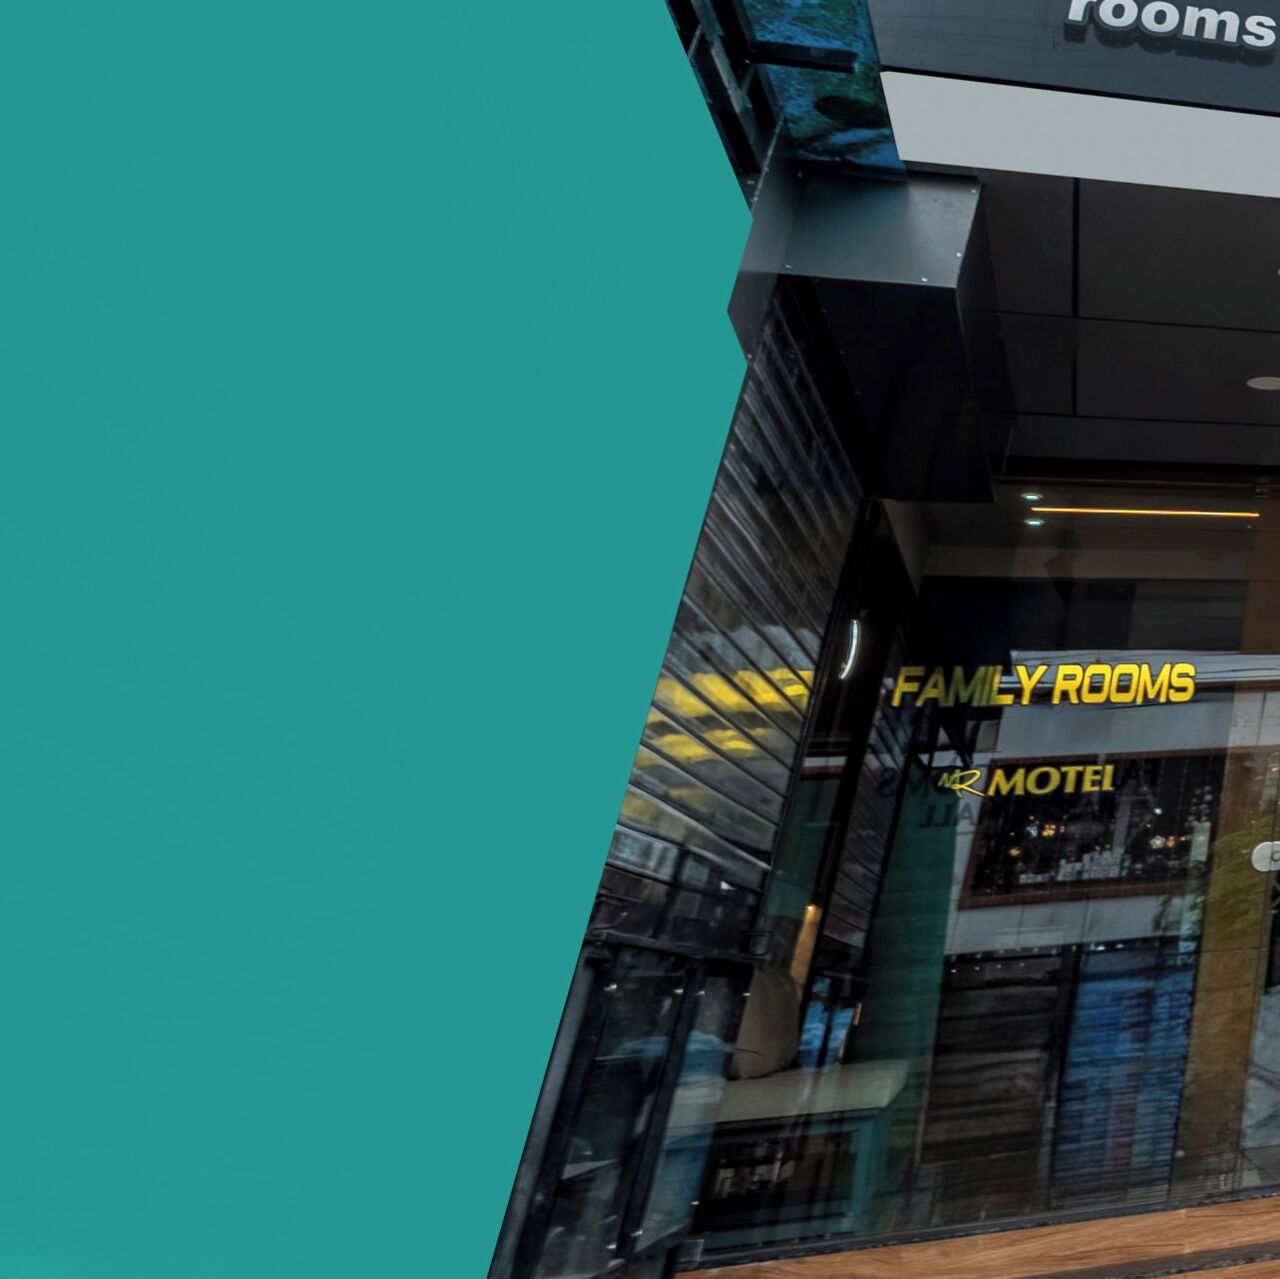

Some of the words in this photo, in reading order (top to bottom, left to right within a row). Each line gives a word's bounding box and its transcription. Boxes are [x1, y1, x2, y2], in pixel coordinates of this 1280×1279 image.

[891, 664, 1049, 707] FAMILY
[1051, 662, 1197, 706] ROOMS
[986, 764, 1115, 797] MOTEL
